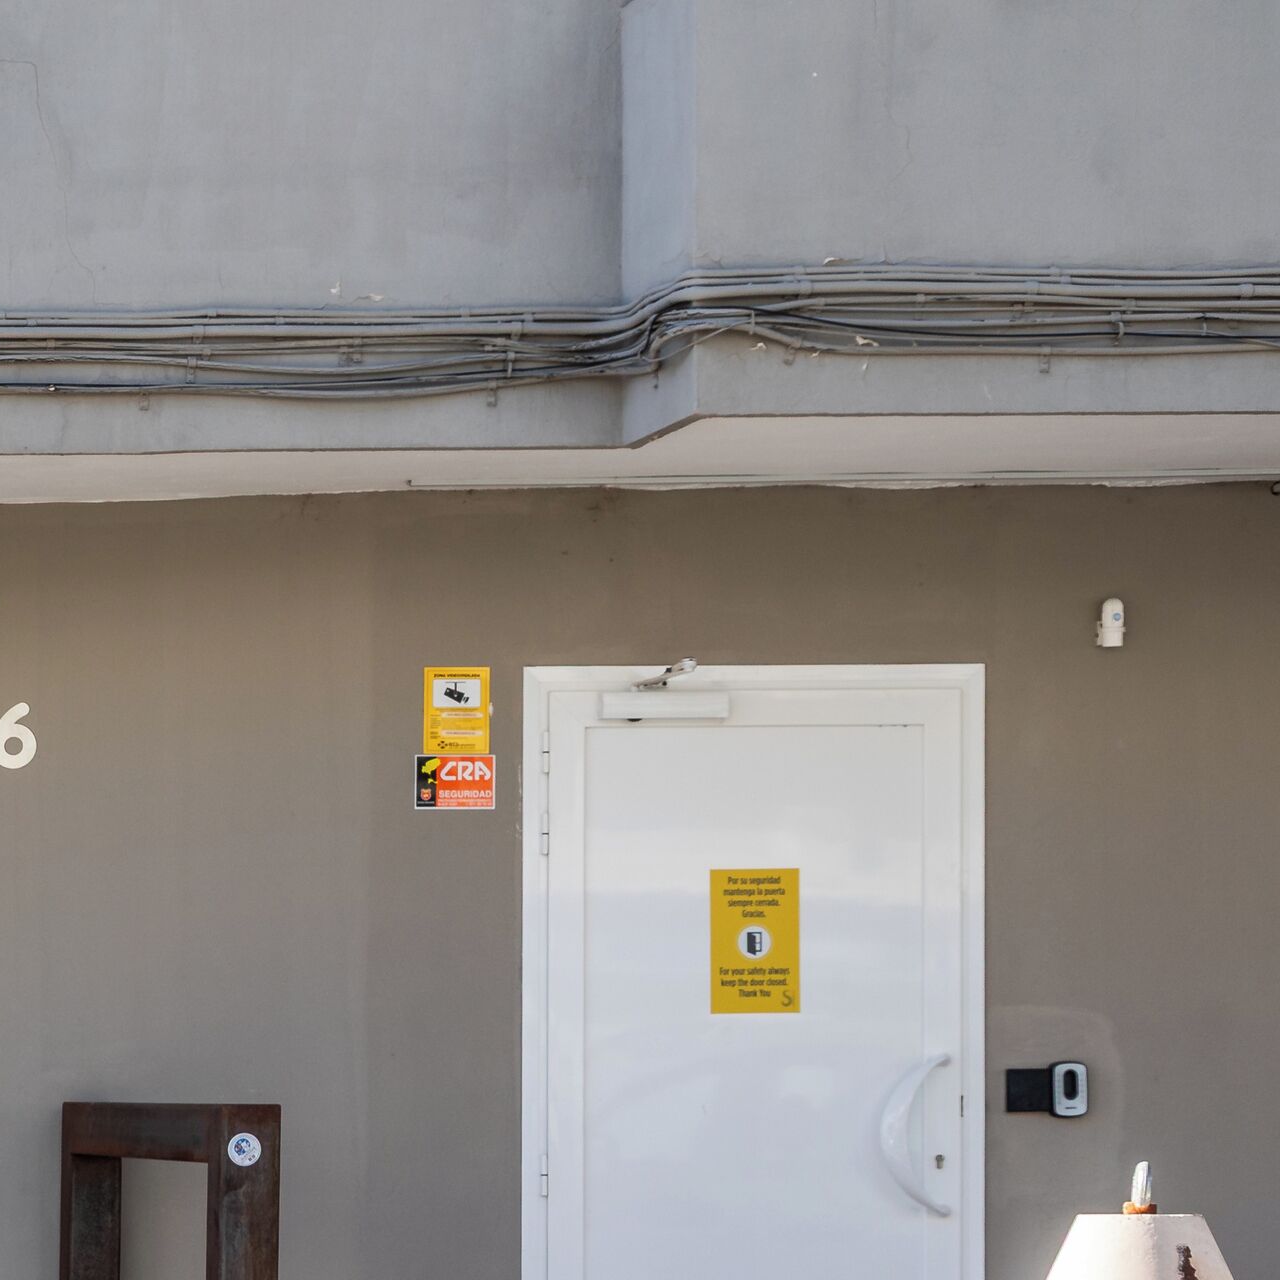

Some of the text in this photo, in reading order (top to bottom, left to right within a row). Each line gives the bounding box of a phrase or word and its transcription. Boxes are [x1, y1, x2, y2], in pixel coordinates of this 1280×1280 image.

[440, 761, 491, 781] CRA
[438, 790, 492, 799] SEGURIDAD
[727, 876, 739, 884] Por
[749, 876, 781, 885] seguridad
[723, 888, 755, 896] mantenga
[764, 888, 785, 896] puerta
[728, 899, 753, 907] siempre
[719, 967, 790, 976] For your safety always
[720, 979, 737, 987] keep
[739, 989, 772, 997] Thank You
